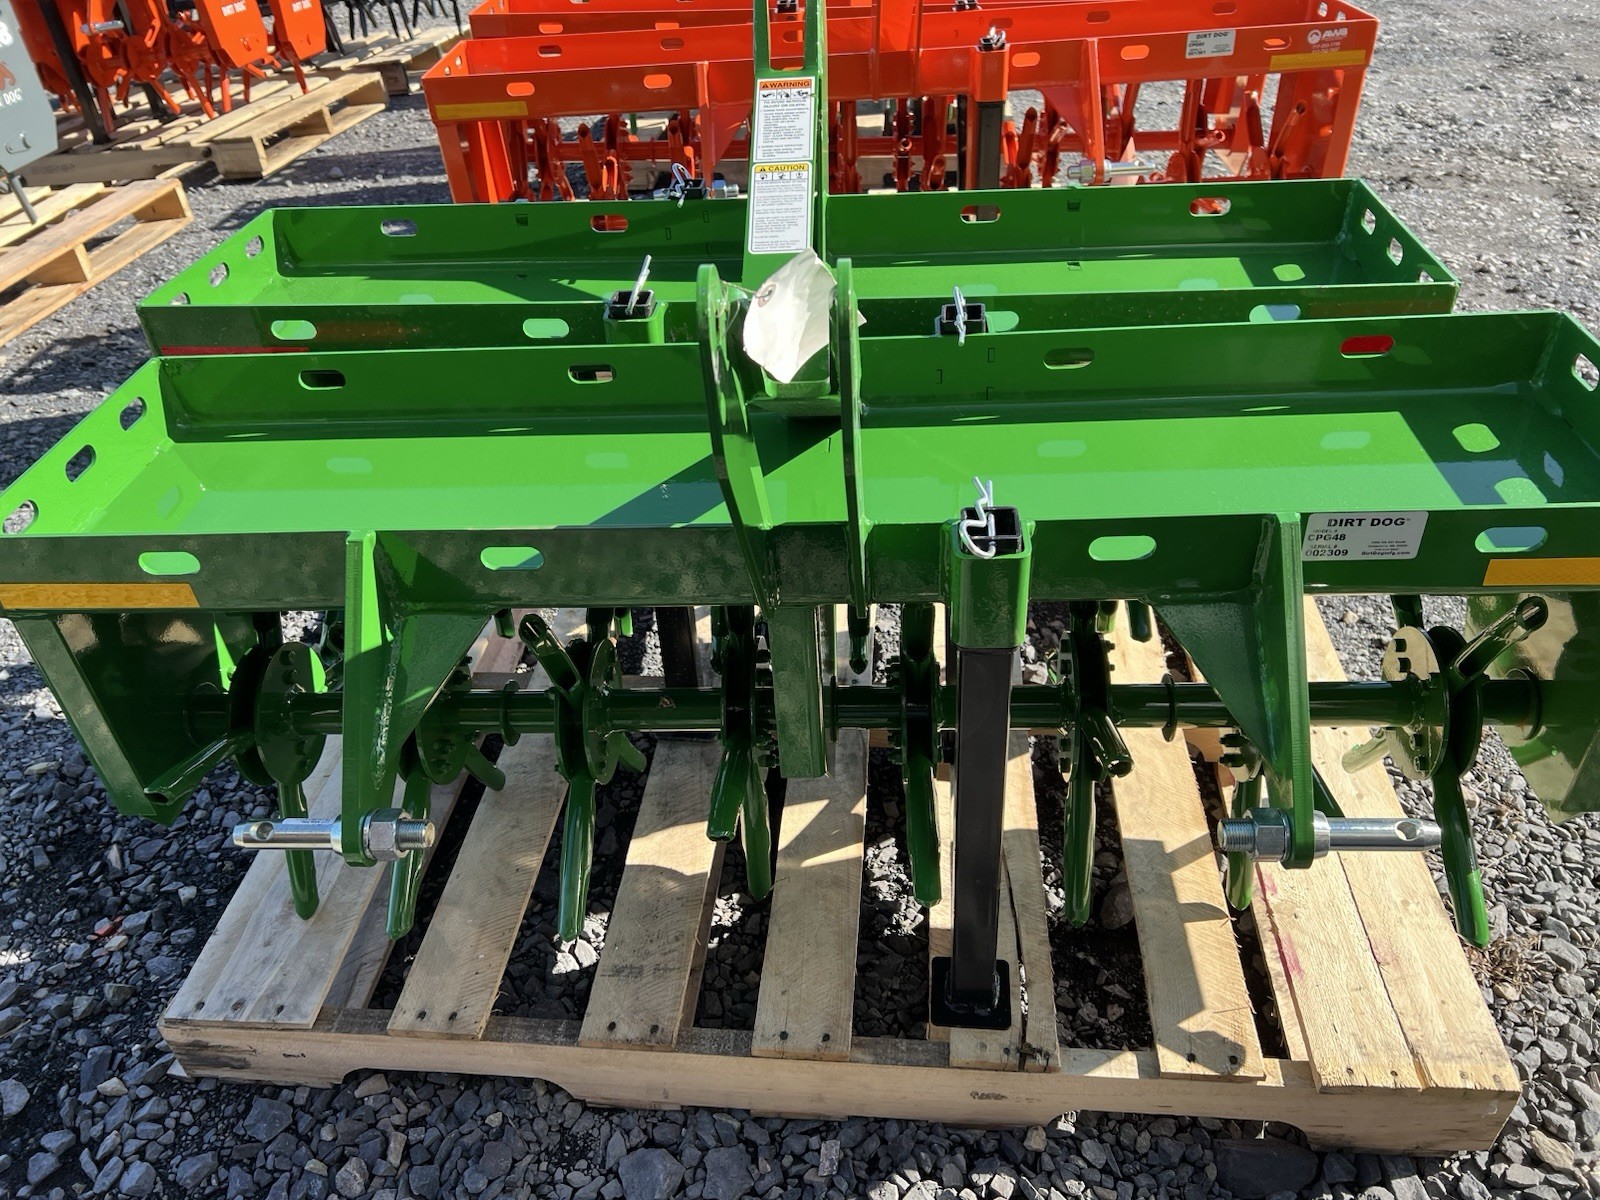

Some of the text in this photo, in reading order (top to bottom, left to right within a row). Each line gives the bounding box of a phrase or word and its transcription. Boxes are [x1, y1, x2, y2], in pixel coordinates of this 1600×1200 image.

[3, 89, 21, 105] DOG
[1327, 517, 1406, 527] DIRT DOG
[1307, 533, 1346, 541] CPG48
[1305, 549, 1349, 557] 002309
